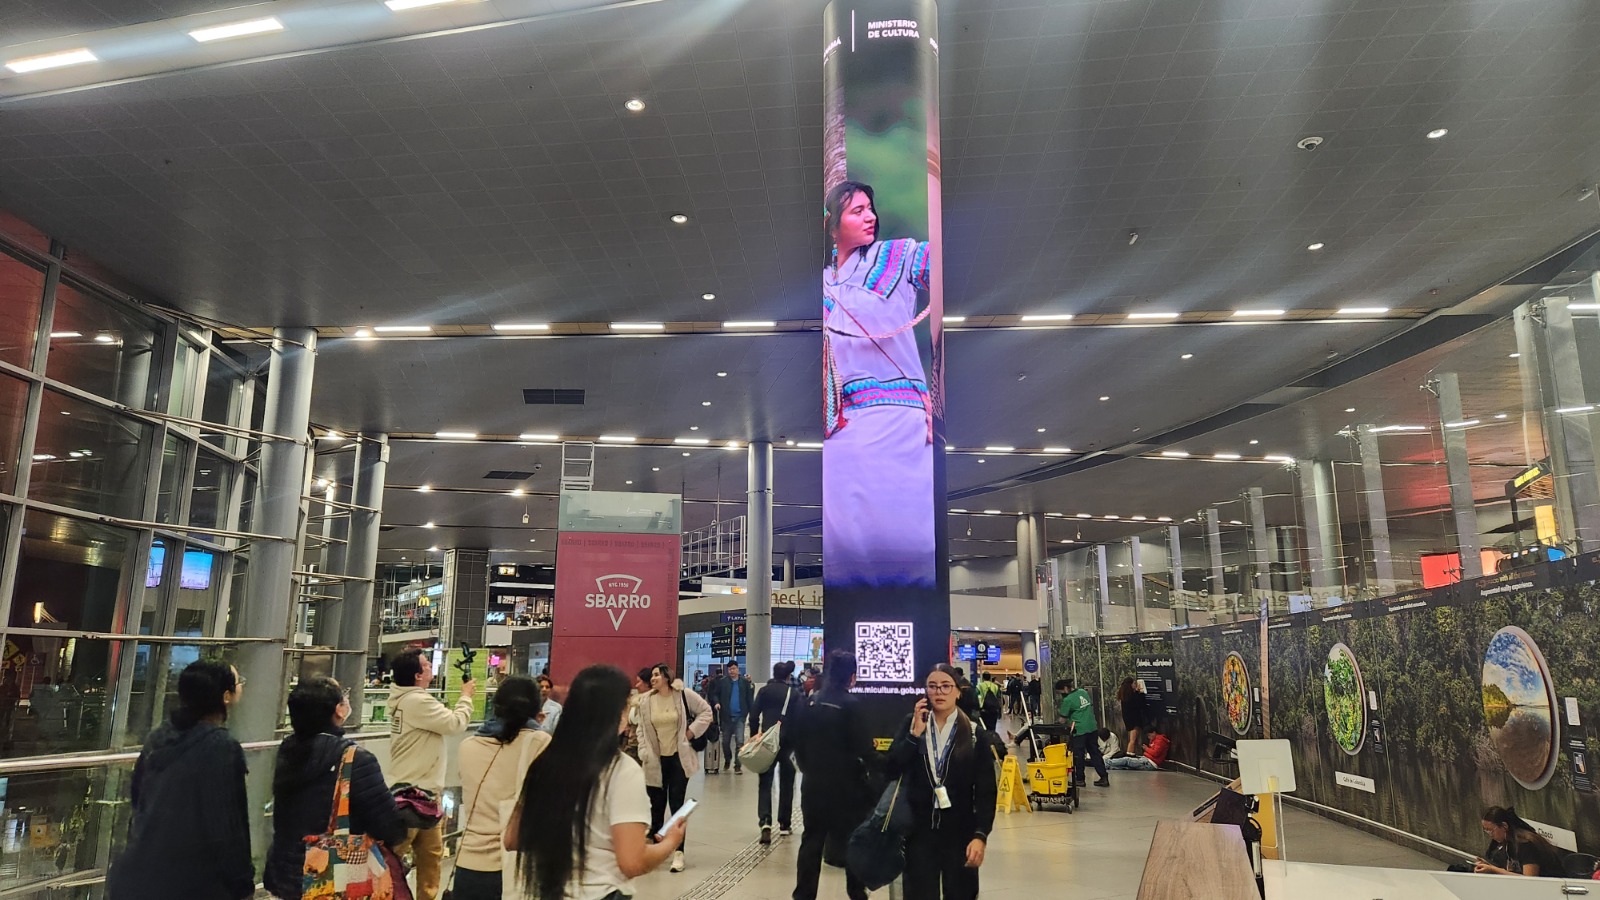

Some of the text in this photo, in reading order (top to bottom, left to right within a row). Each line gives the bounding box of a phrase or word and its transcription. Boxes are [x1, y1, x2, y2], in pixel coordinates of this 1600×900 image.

[868, 19, 917, 30] MINISTERIO
[868, 30, 920, 39] DE CULTURA
[585, 594, 651, 609] SBARRO
